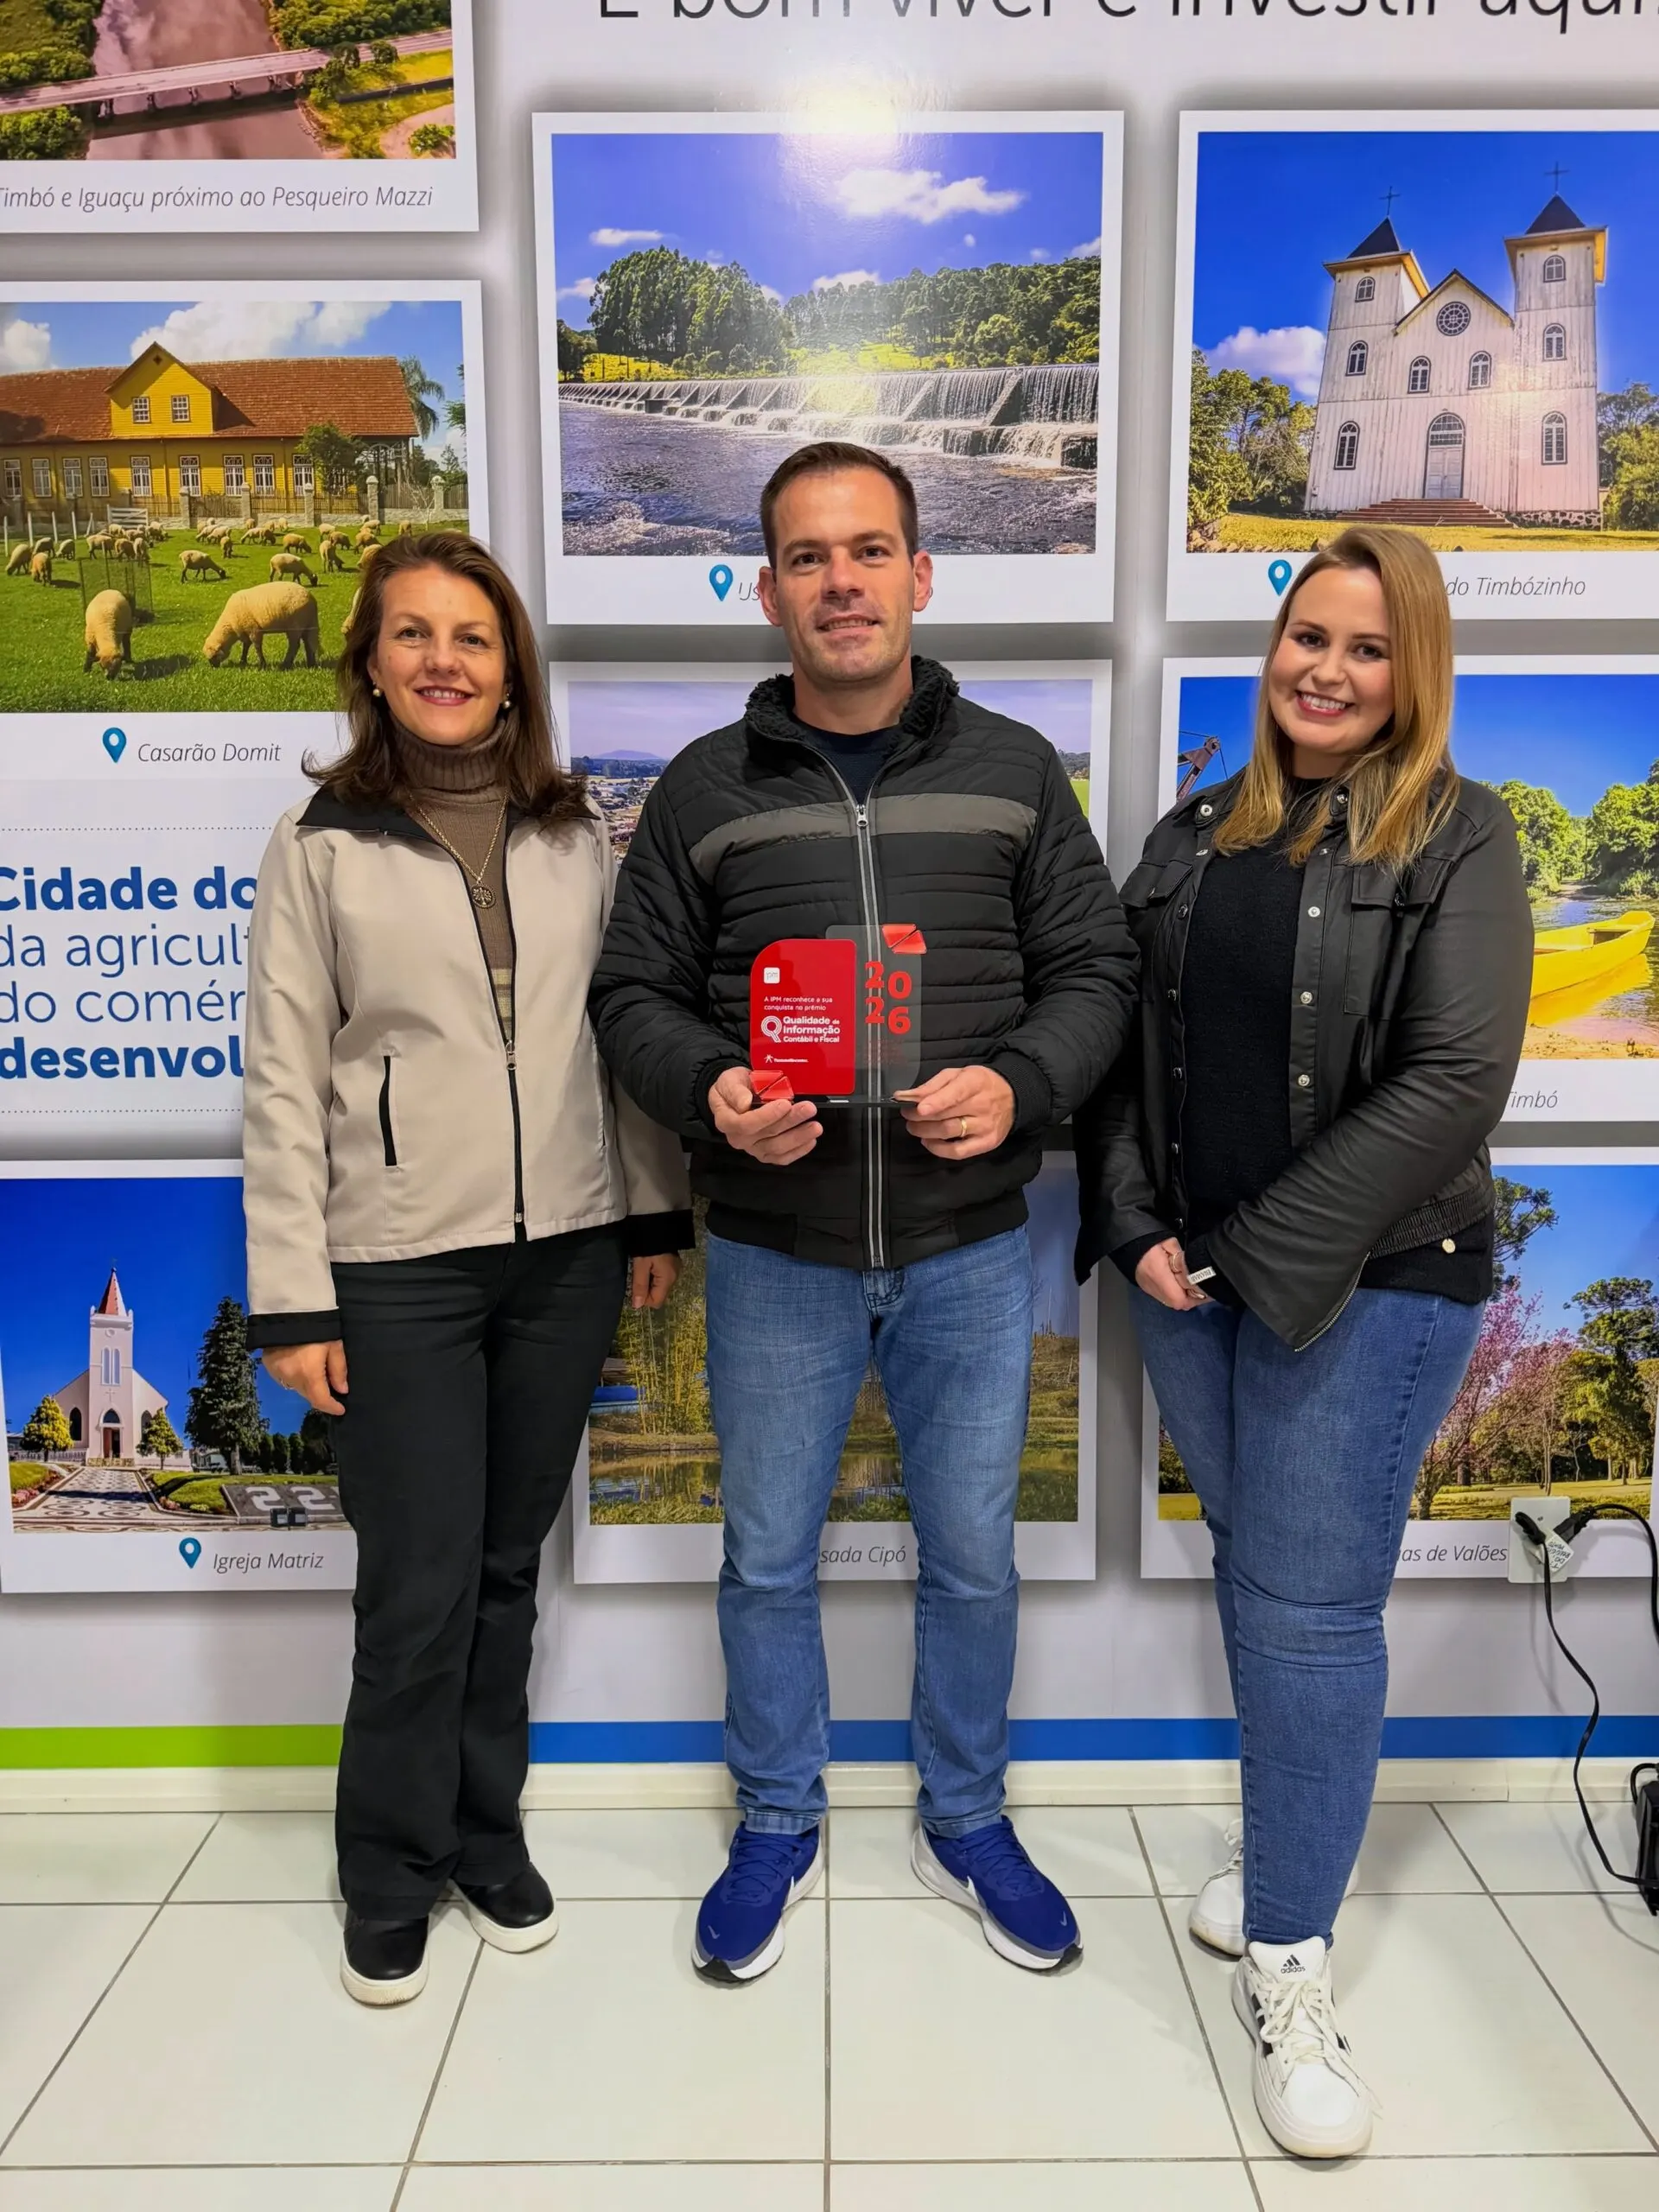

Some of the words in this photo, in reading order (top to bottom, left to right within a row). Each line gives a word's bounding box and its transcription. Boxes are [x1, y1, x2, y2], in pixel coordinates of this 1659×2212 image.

[61, 191, 72, 207] e
[79, 188, 144, 213] Iguaçu
[150, 187, 233, 212] próximo
[240, 191, 265, 207] ao
[272, 186, 368, 211] Pesqueiro
[376, 186, 433, 207] Mazzi
[1446, 577, 1469, 596] do
[1477, 576, 1586, 596] Timbózinho
[138, 743, 216, 762] Casarão
[223, 743, 281, 761] Domit
[0, 866, 178, 911] Cidade
[0, 981, 56, 1023] do
[783, 1015, 830, 1025] Qualidade
[783, 1025, 841, 1037] Informação
[1510, 1090, 1558, 1108] imbó
[868, 1545, 906, 1567] Cipó
[1427, 1545, 1447, 1561] de
[1453, 1545, 1508, 1561] Valões
[213, 1553, 262, 1574] Igreja
[268, 1553, 324, 1568] Matriz
[1280, 1966, 1306, 1974] adidas
